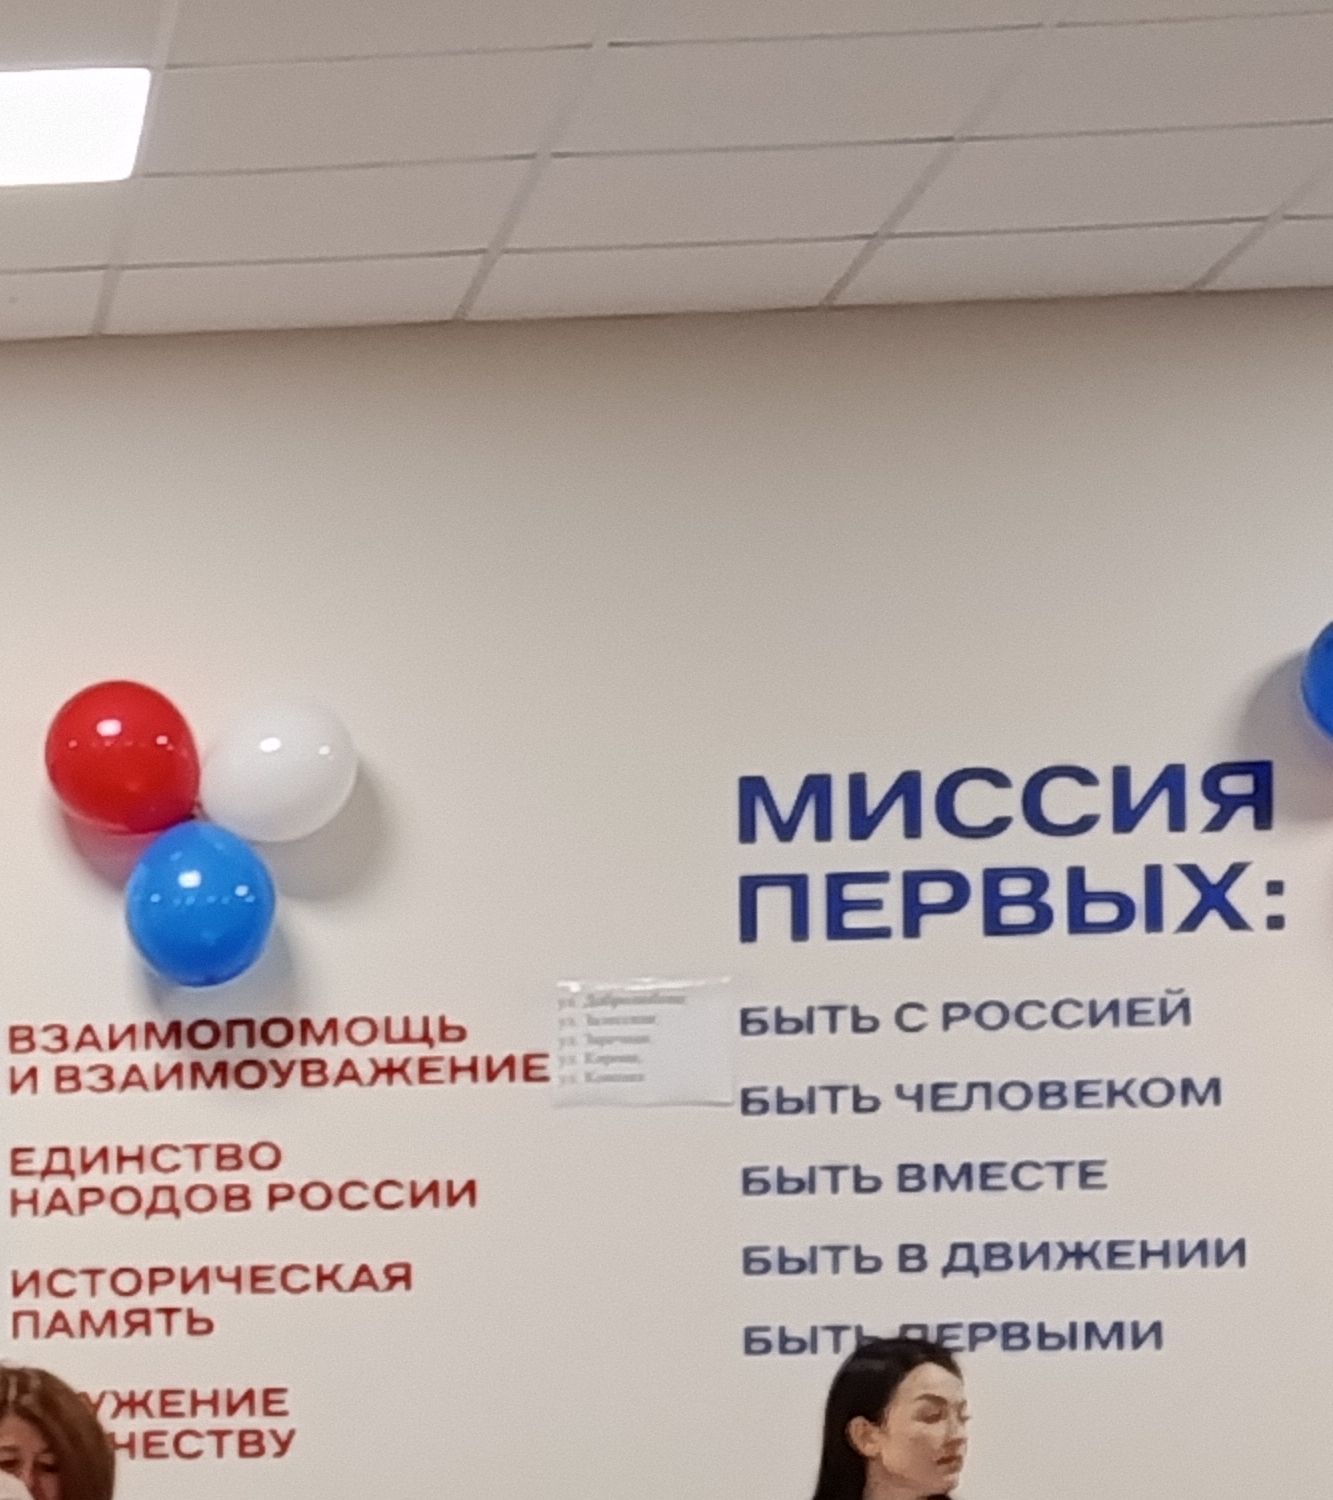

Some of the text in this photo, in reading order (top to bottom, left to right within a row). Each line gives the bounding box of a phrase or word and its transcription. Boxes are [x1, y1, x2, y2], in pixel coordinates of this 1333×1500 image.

[739, 759, 1274, 844] МИССИЯ
[739, 862, 1284, 943] ПЕРВЫХ:
[740, 989, 1191, 1036] БЫТЬ С РОССИЕЙ
[9, 1016, 467, 1053] ВЗАИМОПОМОЩЬ
[10, 1066, 38, 1094] И
[55, 1053, 550, 1093] ВЗАИМОУВАЖЕНИЕ
[741, 1077, 1221, 1116] БЫТЬ ЧЕЛОВЕКОМ
[10, 1141, 282, 1181] ЕДИНСТВО
[742, 1160, 1106, 1195] БЫТЬ ВМЕСТЕ
[11, 1179, 476, 1219] НАРОДОВ РОССИИ
[743, 1238, 1245, 1278] БЫТЬ В ДВИЖЕНИИ
[12, 1262, 412, 1298] ИСТОРИЧЕСКАЯ
[13, 1307, 214, 1338] ПАМЯТЬ
[80, 1387, 290, 1420] УЖЕНИЕ
[104, 1428, 297, 1460] ЧЕСТВУ
